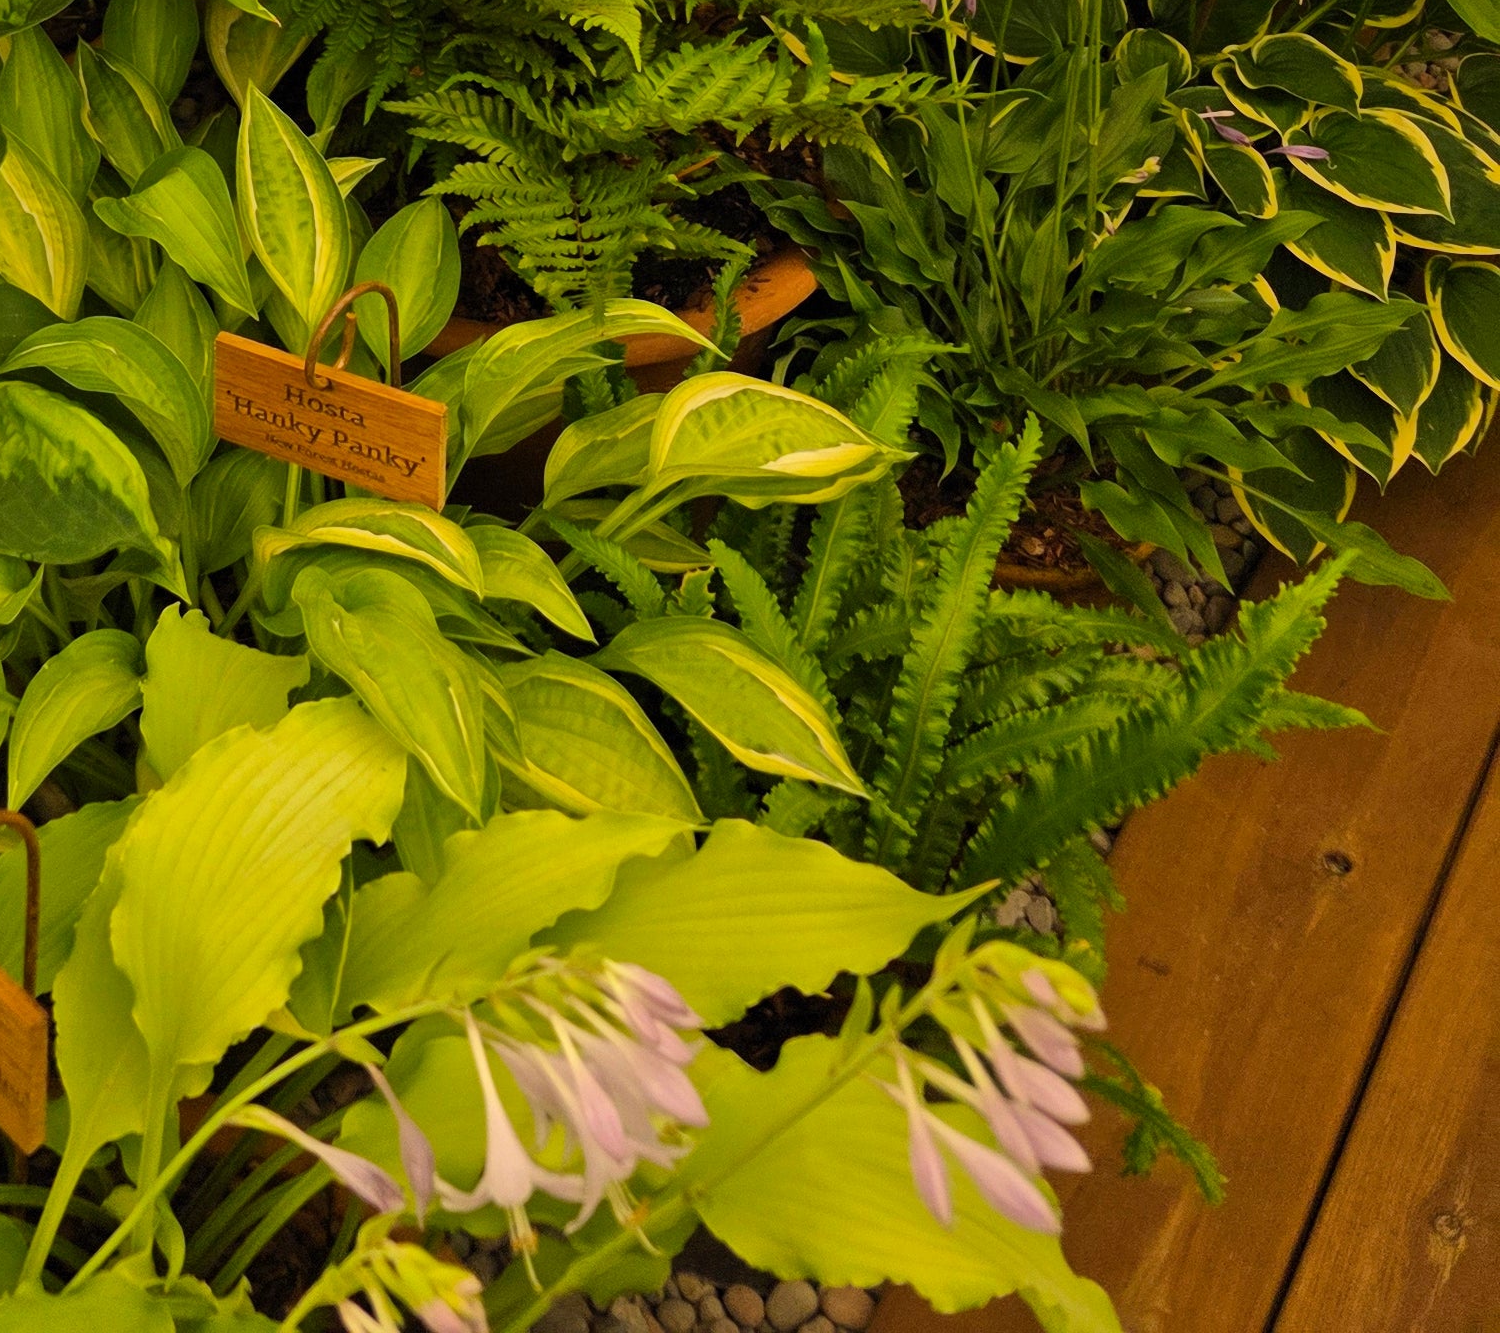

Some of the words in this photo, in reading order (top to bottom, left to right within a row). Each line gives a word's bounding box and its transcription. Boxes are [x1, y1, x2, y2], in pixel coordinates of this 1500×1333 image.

[226, 390, 324, 445] 'Hanky
[333, 429, 427, 478] Panky'
[284, 384, 367, 429] Hosta
